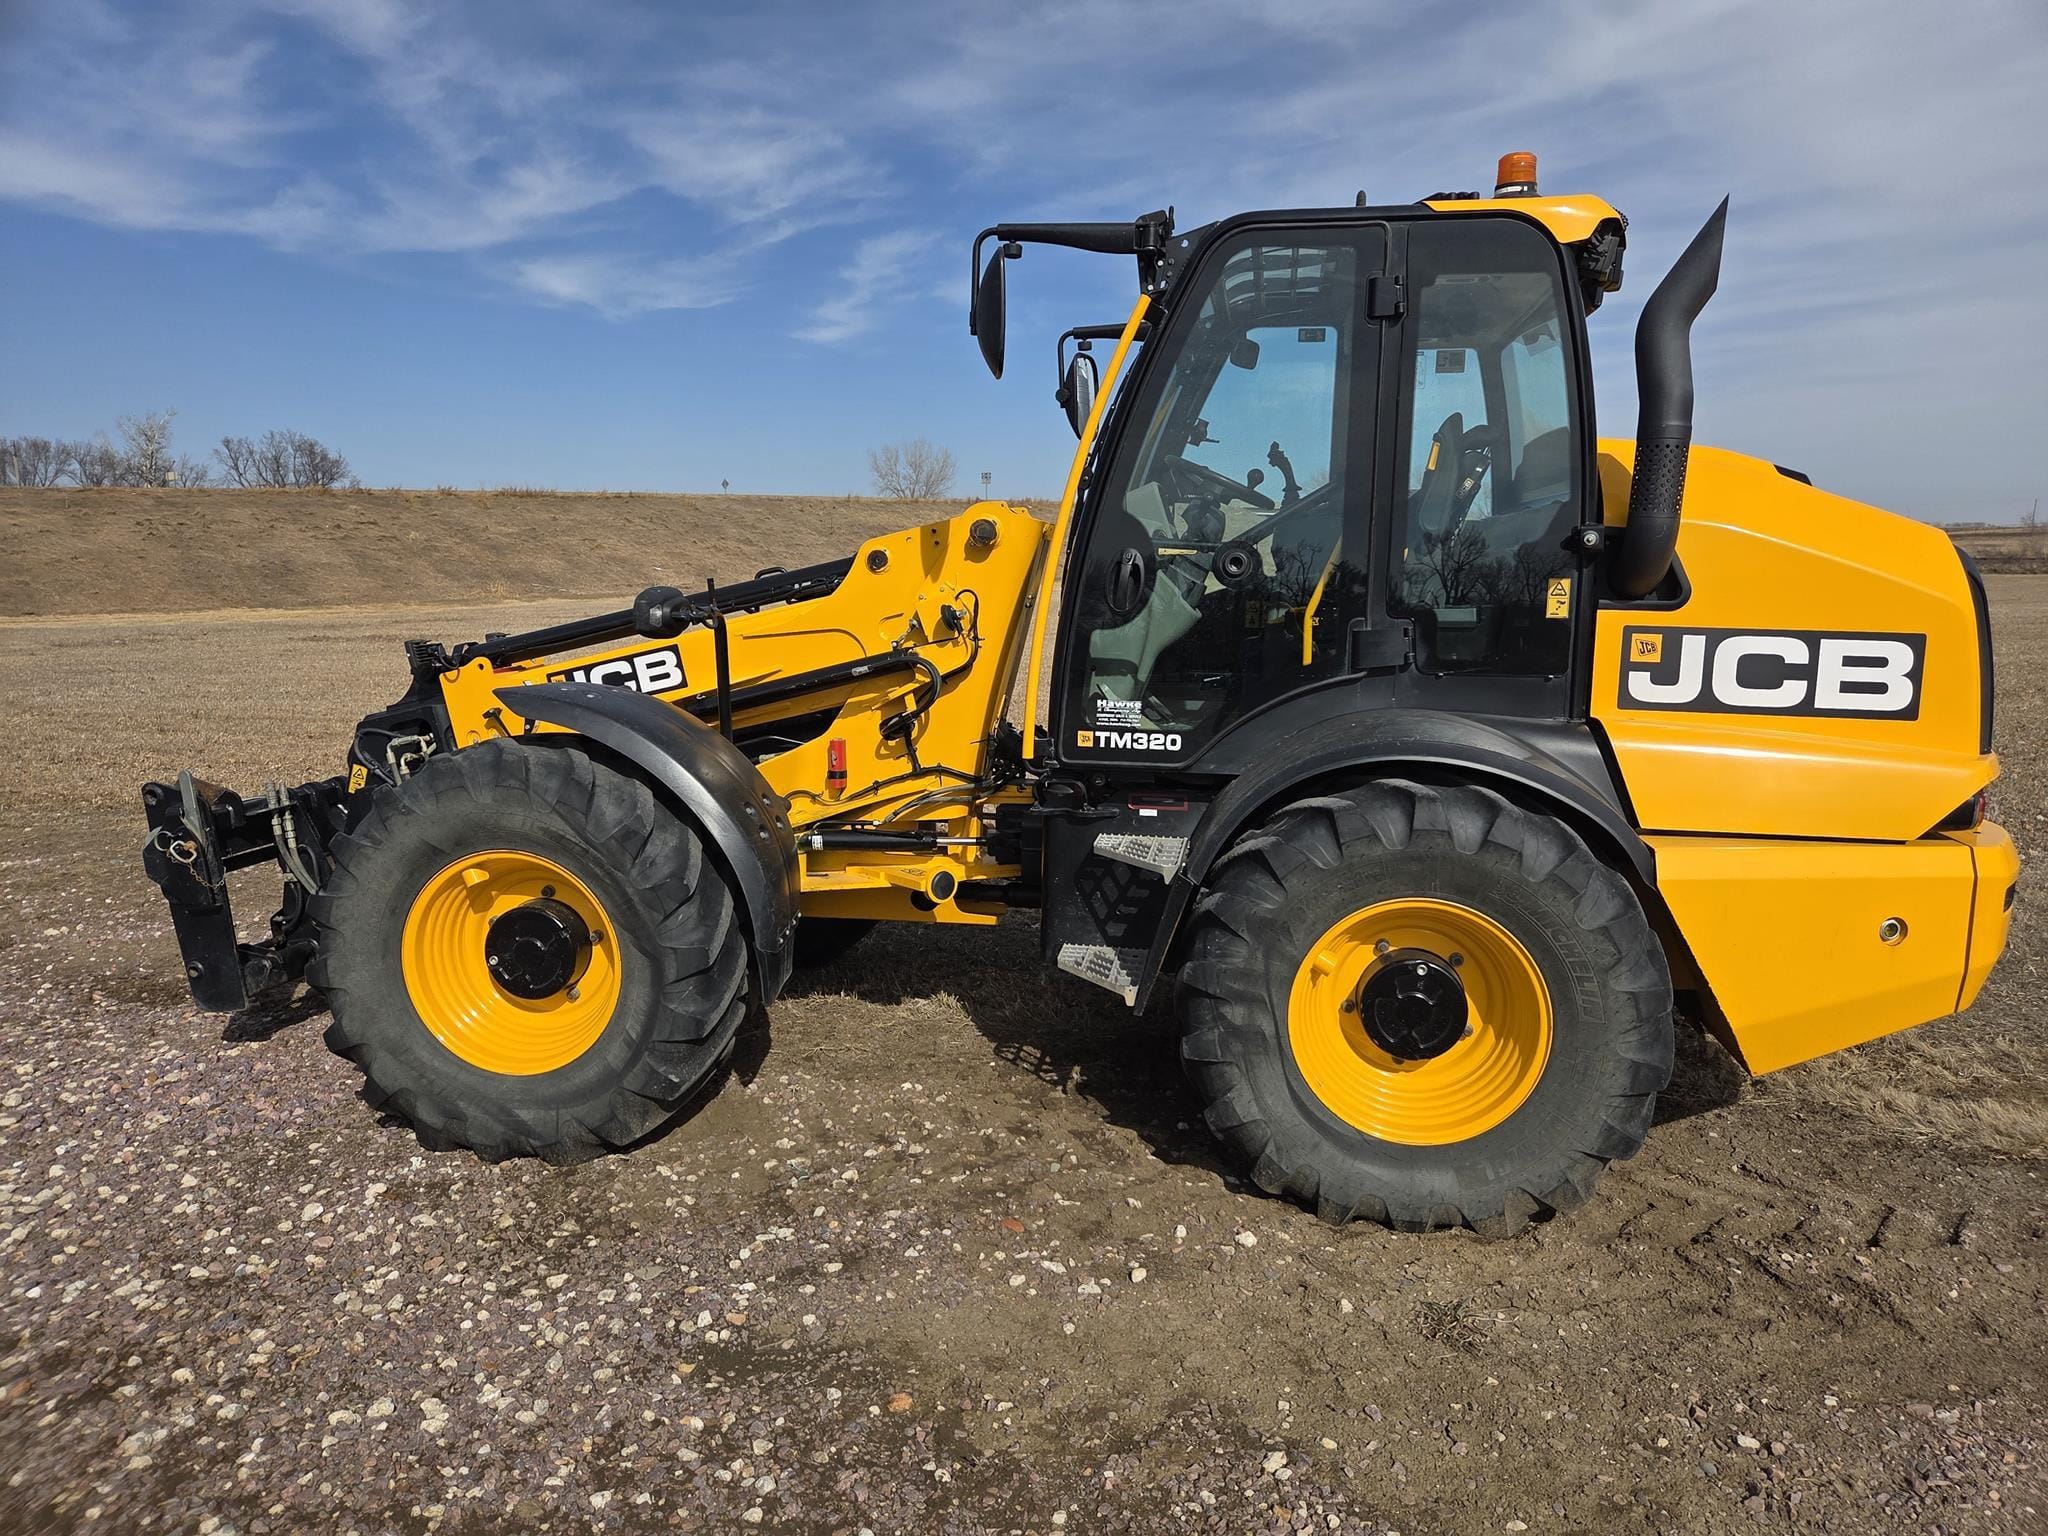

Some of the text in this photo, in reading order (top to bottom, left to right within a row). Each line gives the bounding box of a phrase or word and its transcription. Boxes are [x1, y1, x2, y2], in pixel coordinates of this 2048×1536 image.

[1639, 641, 1657, 655] JCB
[573, 650, 683, 693] CB
[1628, 634, 1915, 712] JCB
[1096, 699, 1142, 709] Hawke
[1094, 731, 1182, 751] TM320
